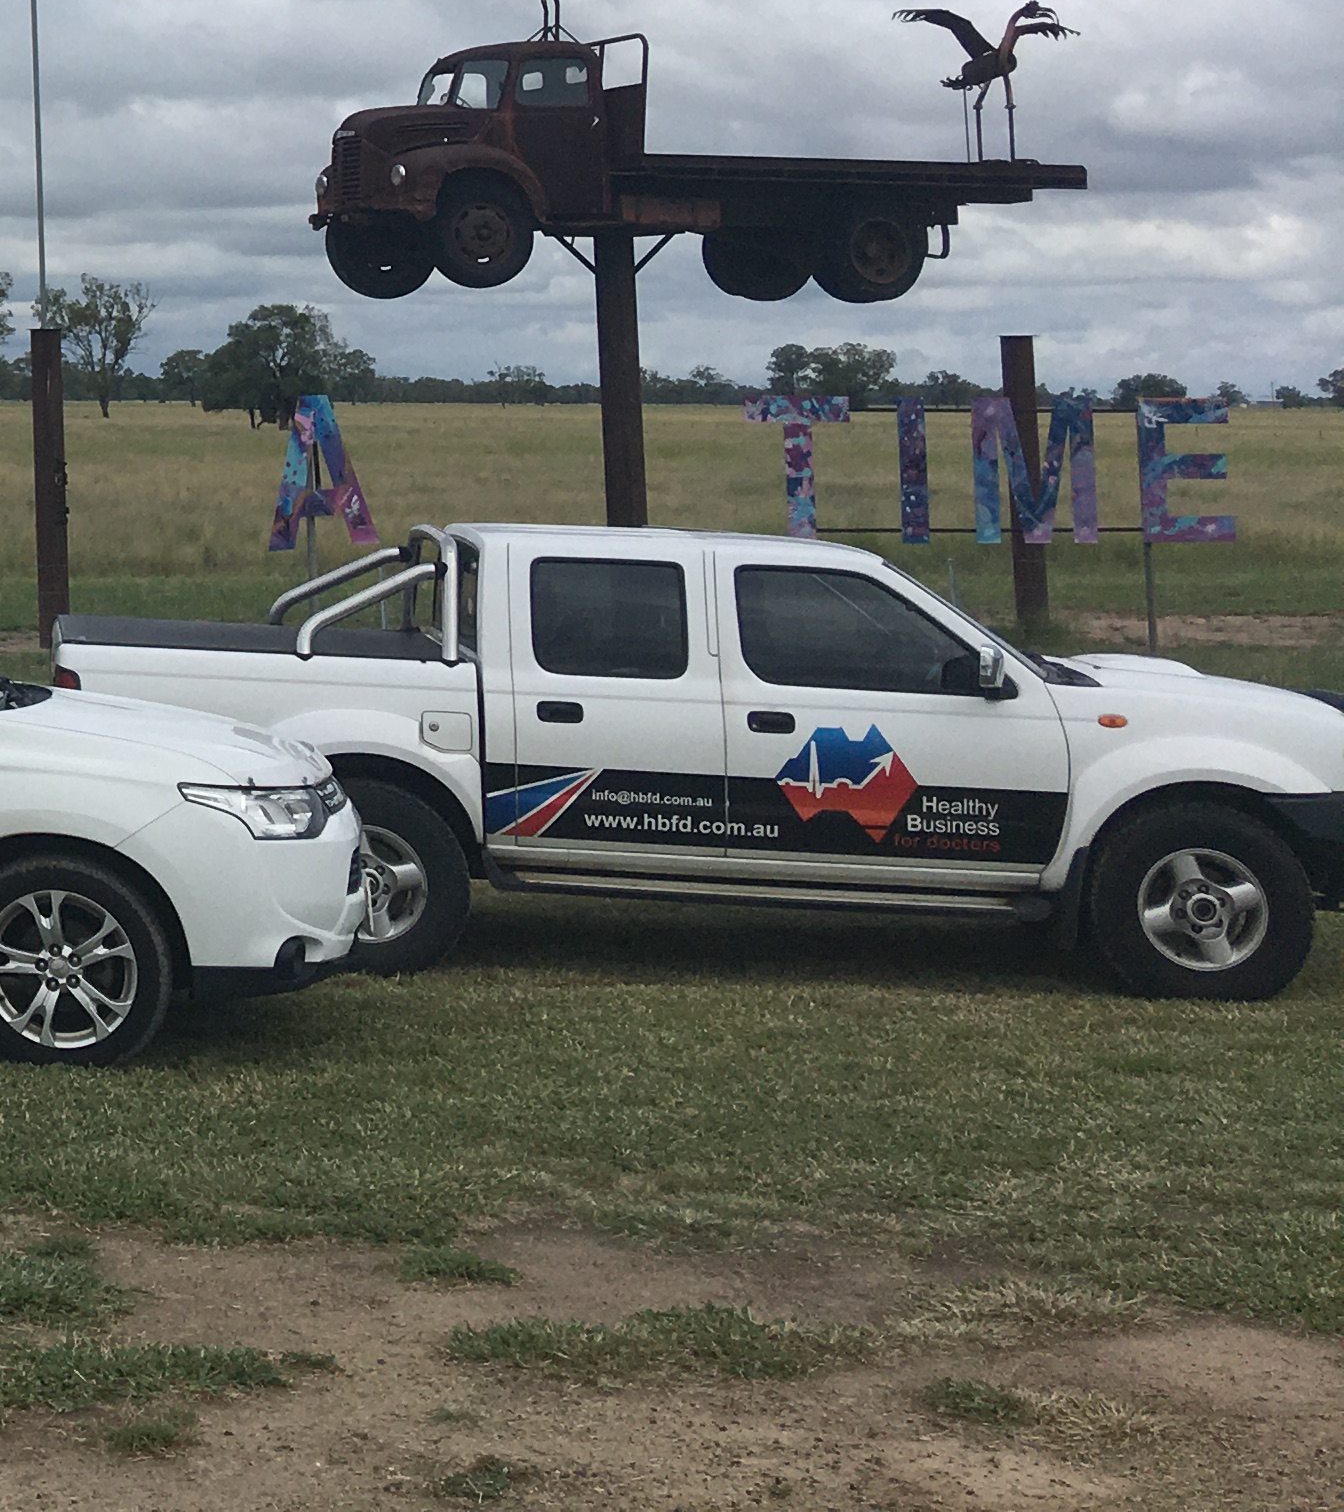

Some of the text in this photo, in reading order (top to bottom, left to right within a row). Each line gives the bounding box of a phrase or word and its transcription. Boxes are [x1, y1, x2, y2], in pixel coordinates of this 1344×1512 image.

[268, 394, 380, 552] A
[742, 395, 1237, 545] TIME
[592, 789, 712, 807] info@hbfd.com.au
[922, 796, 999, 819] Healthy
[584, 813, 779, 838] www.hbfd.com.au
[907, 815, 1000, 836] Business
